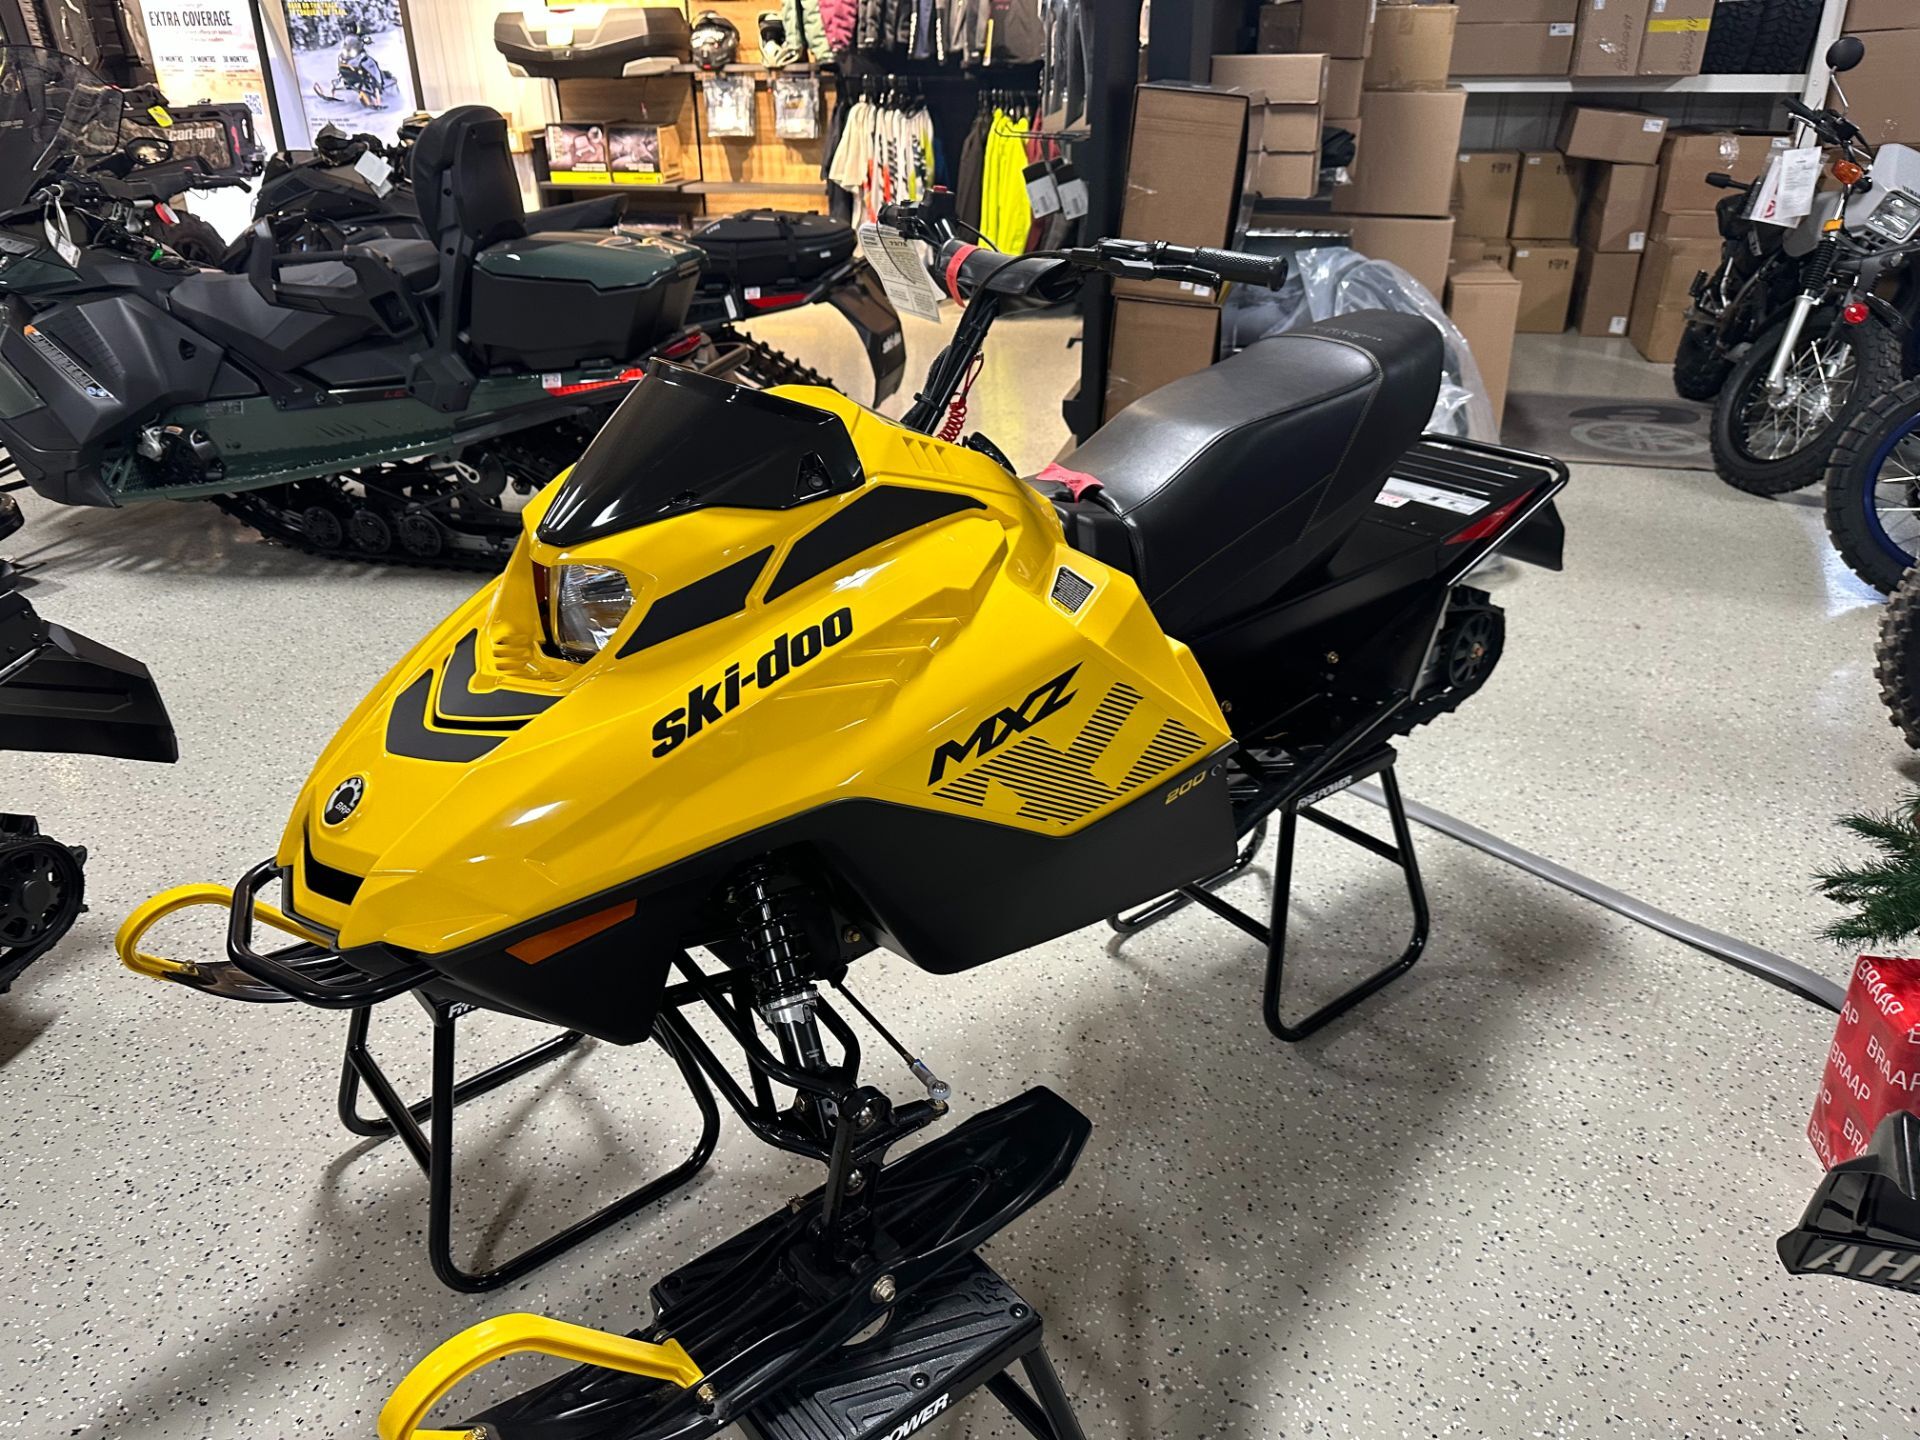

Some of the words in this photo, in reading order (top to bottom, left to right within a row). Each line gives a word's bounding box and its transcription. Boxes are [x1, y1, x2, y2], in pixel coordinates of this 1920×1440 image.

[149, 11, 180, 26] EXTRA
[182, 10, 233, 26] COVERAGE
[169, 126, 216, 141] can-am
[652, 607, 853, 758] ski-doo
[928, 661, 1084, 786] MXZ
[334, 801, 352, 814] BRP
[1165, 770, 1207, 805] 200
[1856, 959, 1904, 1016] BRAAP
[1830, 1041, 1871, 1100] BRAAP
[1810, 1120, 1839, 1168] BRAA
[1843, 1117, 1868, 1157] BRA
[1803, 1244, 1920, 1282] AH
